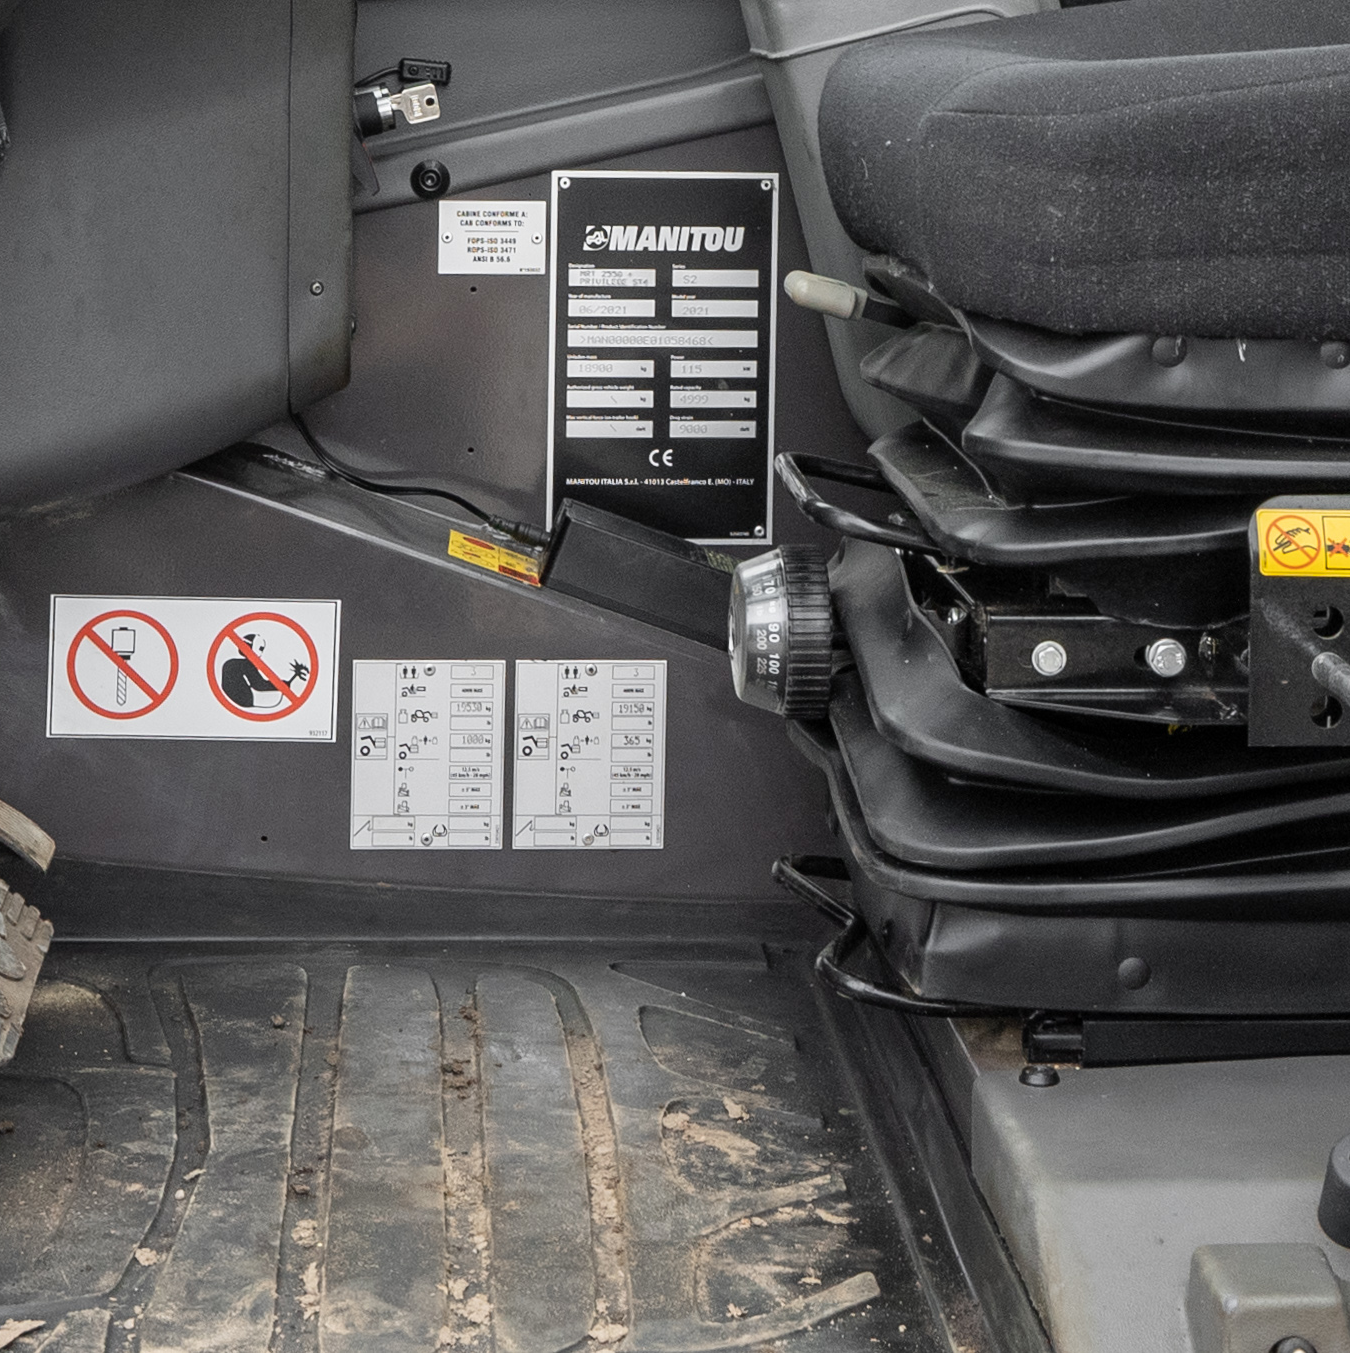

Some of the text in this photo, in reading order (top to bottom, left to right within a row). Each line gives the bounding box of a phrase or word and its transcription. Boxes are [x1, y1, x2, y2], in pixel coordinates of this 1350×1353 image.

[456, 210, 480, 218] CABINE
[482, 210, 519, 218] CONFORME
[609, 225, 745, 252] MANITOU
[683, 275, 697, 284] S2
[579, 305, 627, 314] 06/2021
[682, 306, 709, 315] 2021
[578, 363, 613, 373] 18900
[681, 364, 702, 373] 115
[680, 394, 709, 404] 4999
[679, 424, 708, 434] 9000
[649, 449, 673, 467] CE
[715, 478, 731, 486] (MO)
[768, 623, 780, 643] 90
[756, 629, 767, 650] 200
[768, 653, 780, 675] 100
[623, 735, 640, 745] 365
